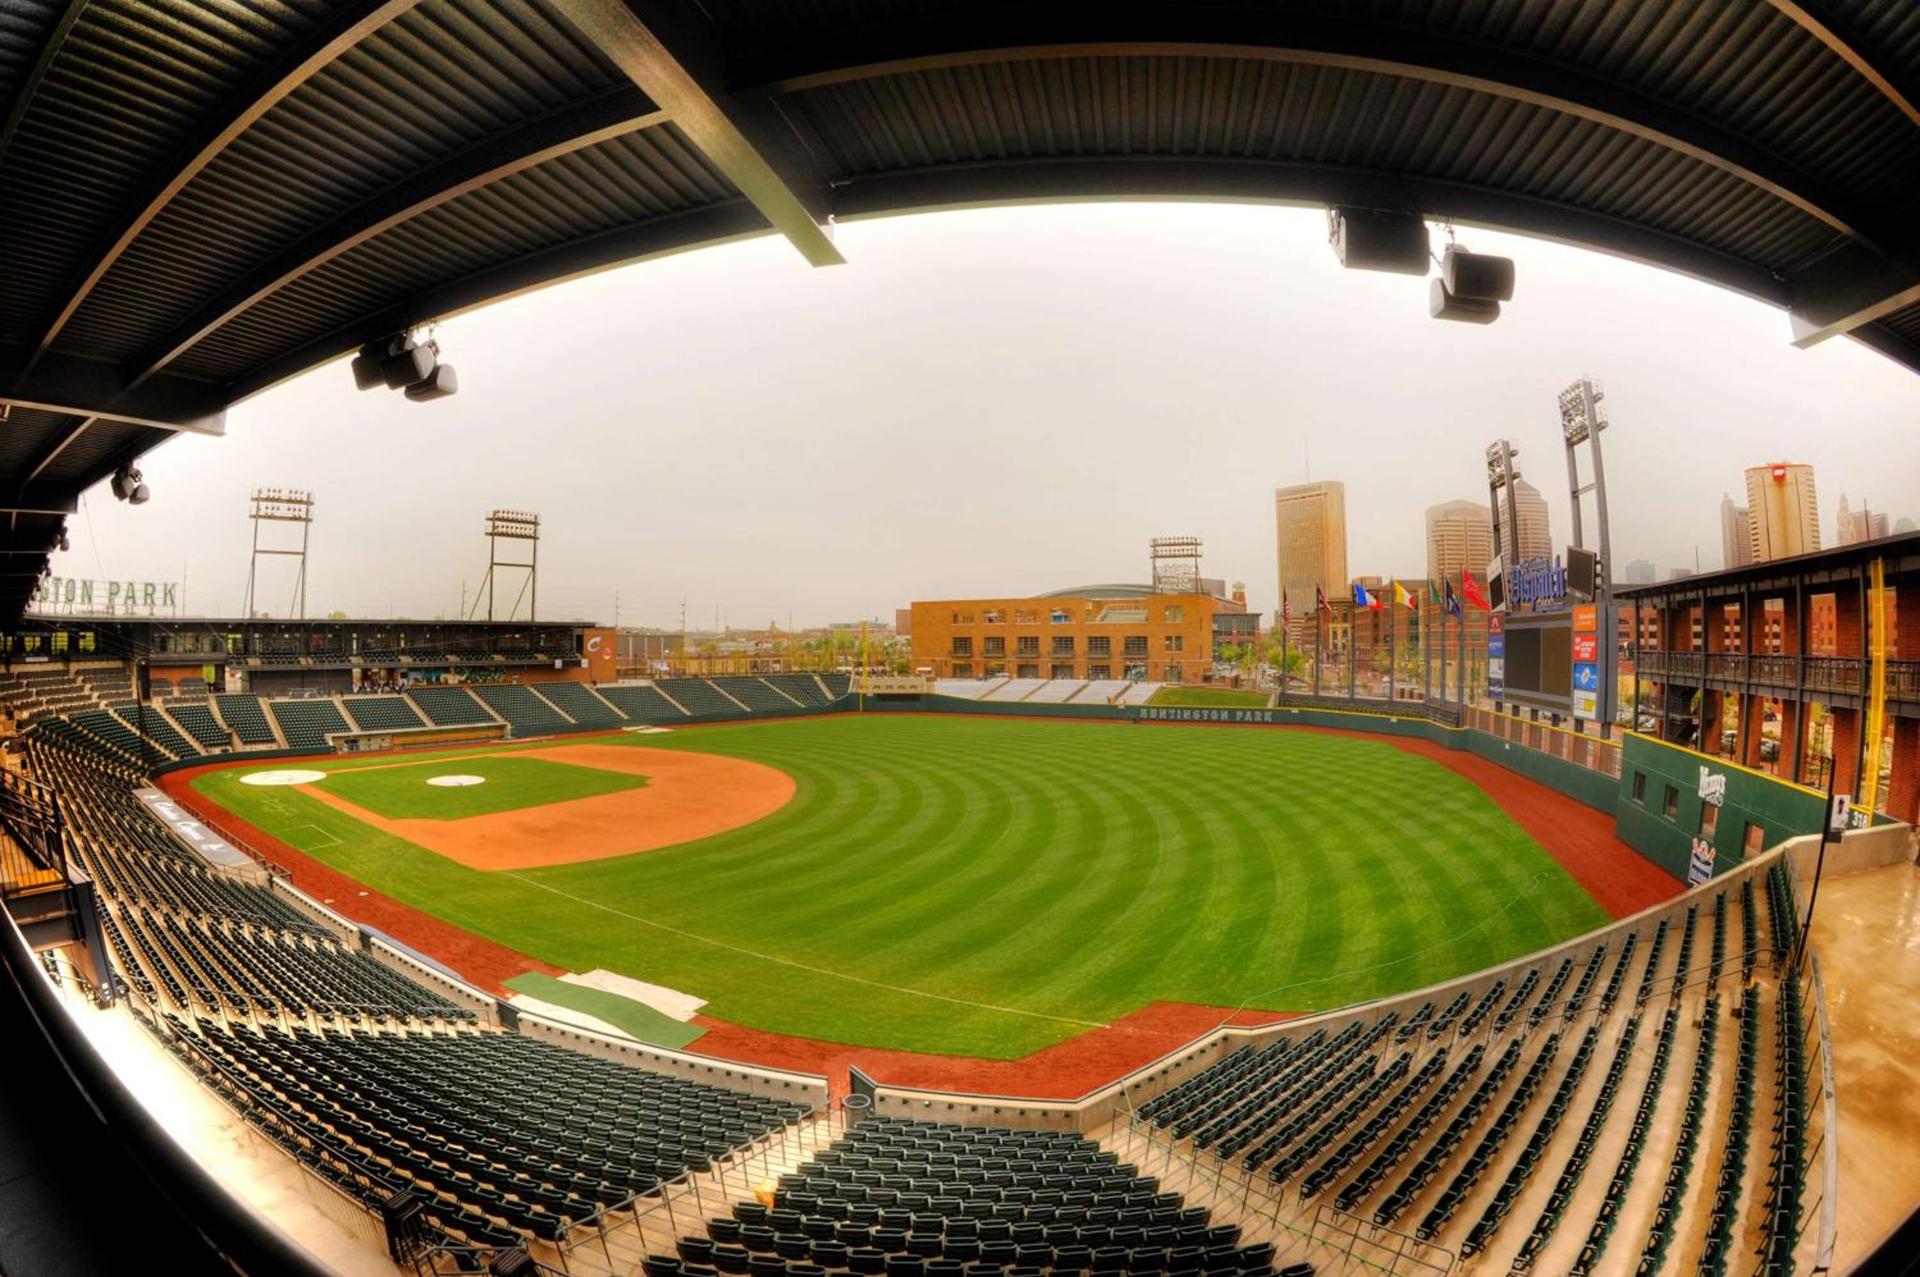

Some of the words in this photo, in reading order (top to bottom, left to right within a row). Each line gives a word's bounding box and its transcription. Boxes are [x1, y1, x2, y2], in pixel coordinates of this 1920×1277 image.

[108, 581, 178, 606] PARK
[1140, 708, 1229, 720] HUNTINGTON
[1236, 710, 1273, 723] PARK
